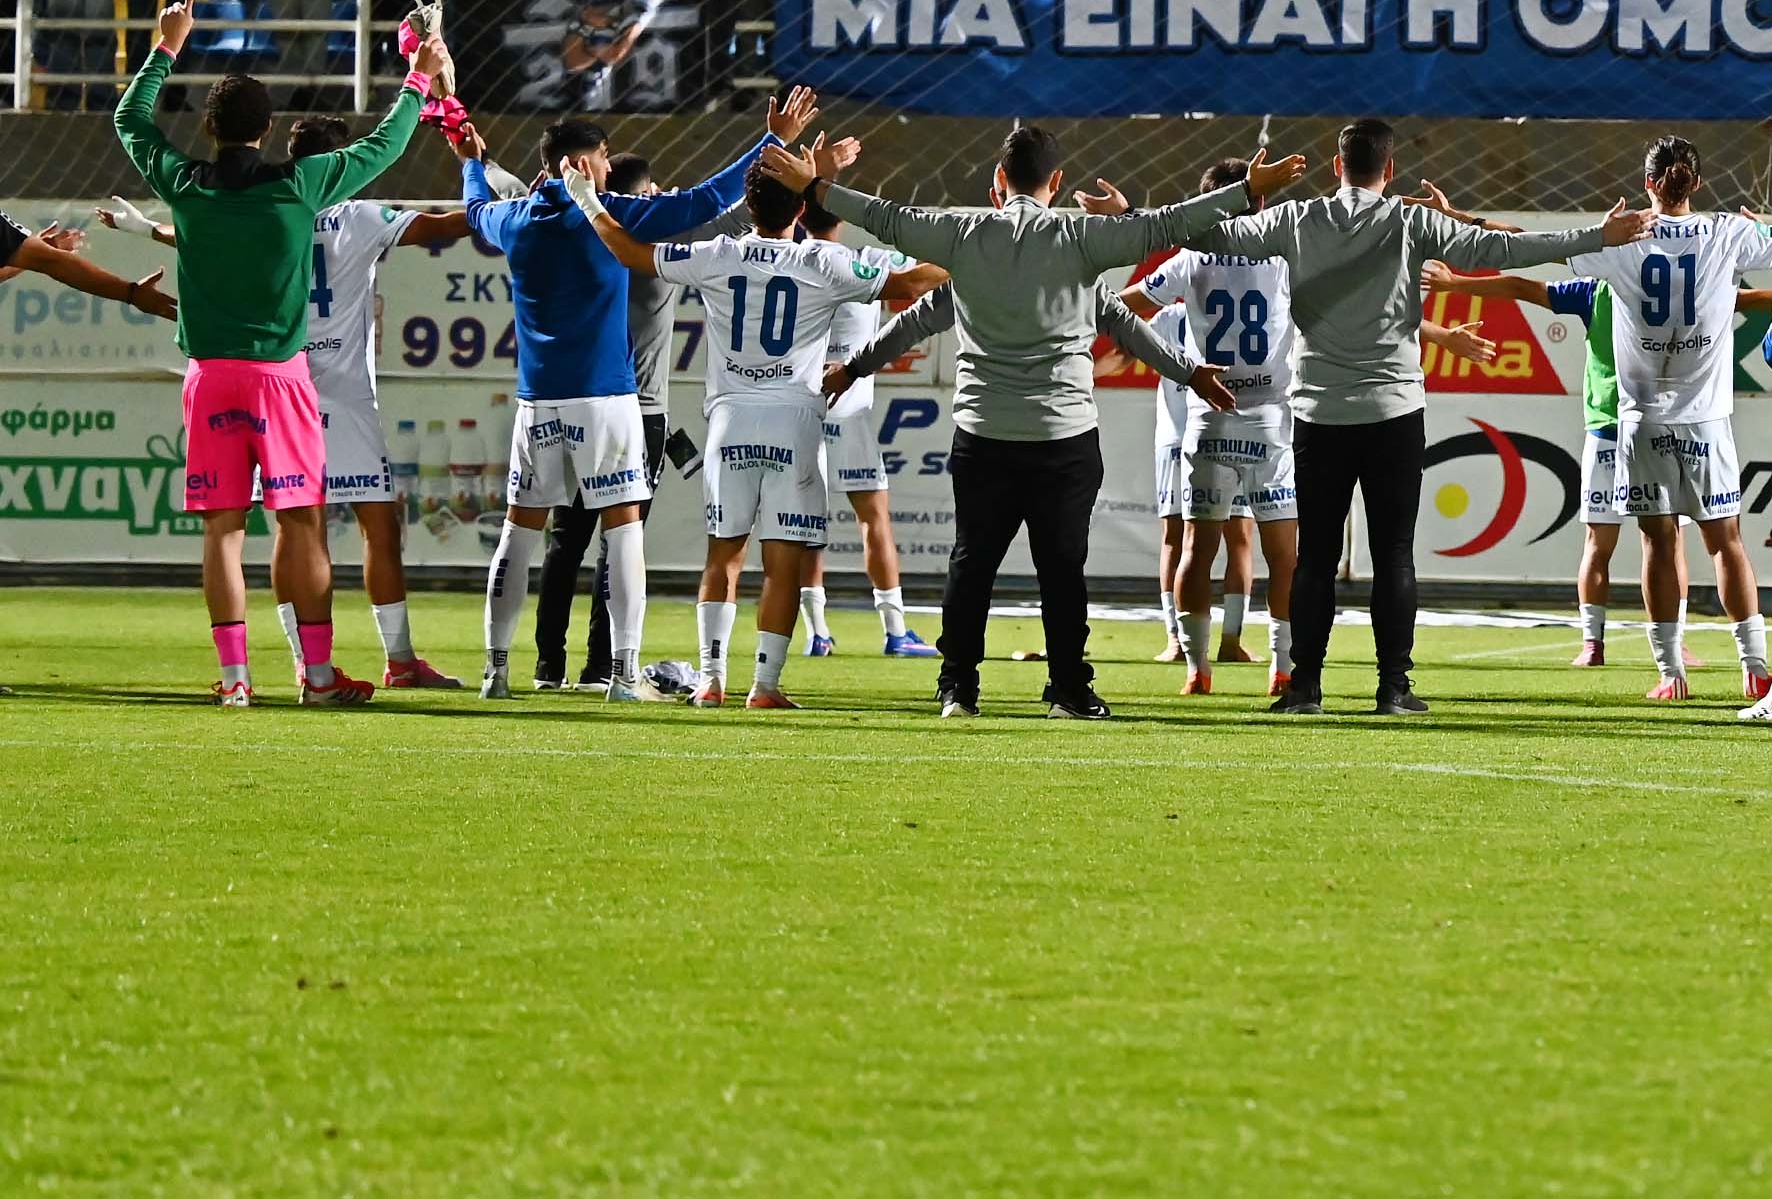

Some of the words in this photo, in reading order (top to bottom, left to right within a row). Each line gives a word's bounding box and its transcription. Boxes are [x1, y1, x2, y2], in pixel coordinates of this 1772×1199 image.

[1640, 253, 1696, 327] 91
[727, 275, 799, 357] 10
[1205, 288, 1269, 366] 28
[719, 444, 794, 465] PETROLINA
[729, 459, 760, 472] ITALOS
[582, 468, 642, 491] VIMATEC
[838, 468, 878, 481] VIMATEC
[1702, 490, 1741, 508] VIMATE
